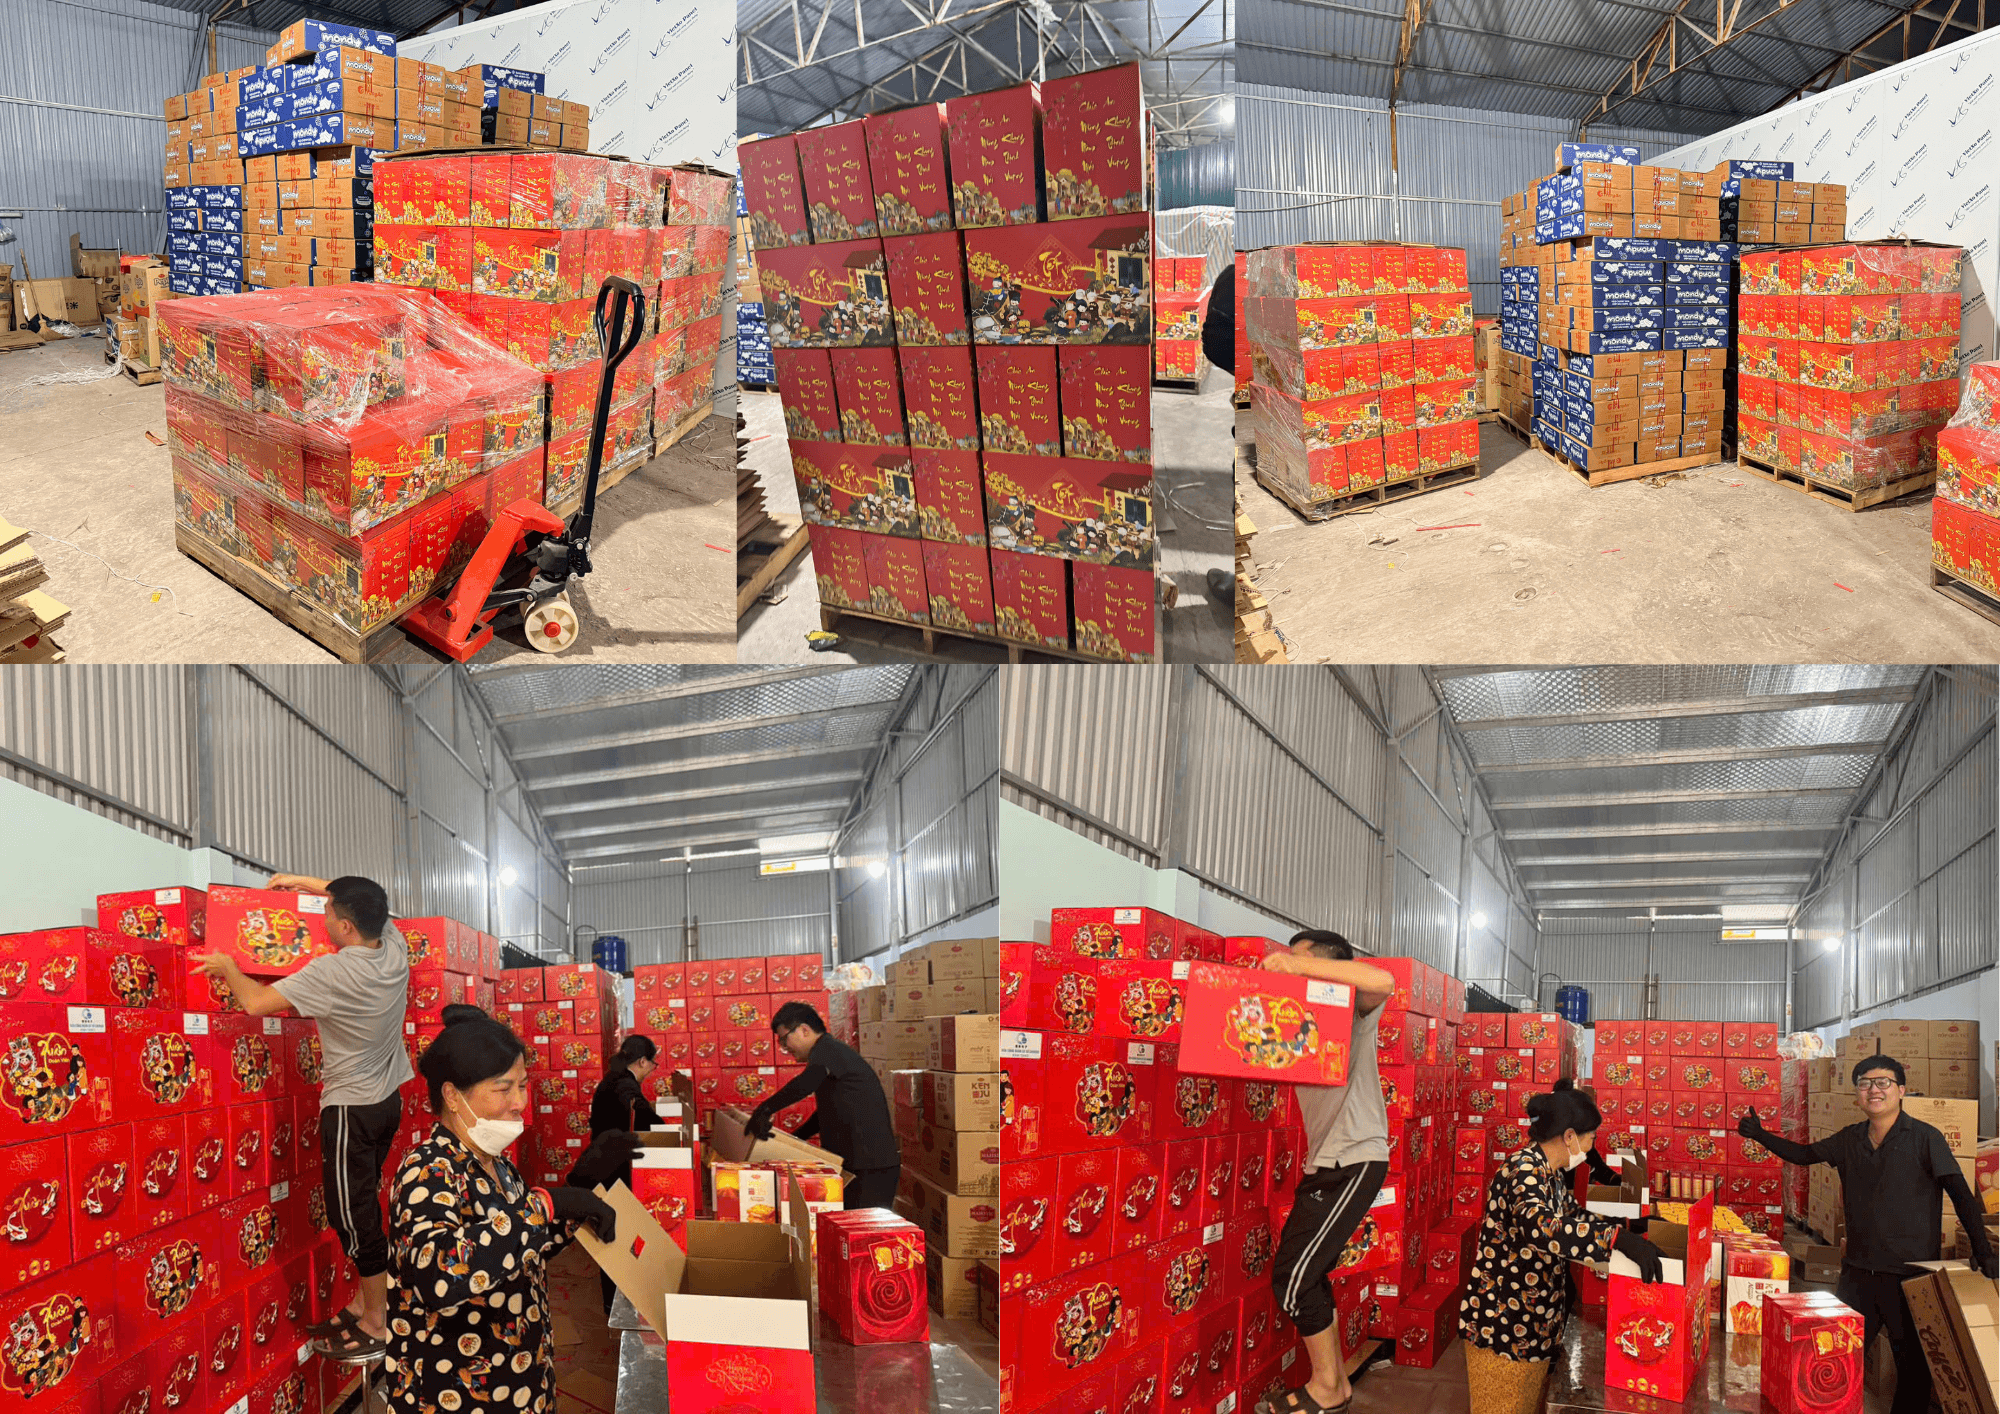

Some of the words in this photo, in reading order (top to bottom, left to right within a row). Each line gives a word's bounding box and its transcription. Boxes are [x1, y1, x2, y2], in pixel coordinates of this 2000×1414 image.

[682, 7, 698, 21] Panel
[321, 32, 363, 49] mondy
[345, 60, 374, 73] mondy
[678, 63, 693, 77] Panel
[508, 76, 535, 88] mondy
[613, 80, 627, 92] Panel
[1978, 73, 1993, 89] Panel
[445, 83, 468, 93] mondy
[293, 92, 318, 109] mondy
[674, 118, 689, 131] Panel
[292, 124, 318, 139] mondy
[348, 126, 375, 135] mondy
[402, 133, 426, 143] mondy
[1976, 129, 1991, 143] Panel
[1576, 150, 1610, 160] mondy
[1587, 172, 1612, 180] mondy
[1755, 167, 1783, 177] mondy
[1975, 184, 1989, 197] Panel
[1973, 238, 1987, 251] Panel
[1625, 245, 1656, 255] mondy
[1677, 246, 1706, 256] mondy
[1621, 268, 1652, 279] mondy
[1692, 269, 1720, 279] mondy
[1605, 290, 1637, 300] mondy
[1677, 289, 1705, 299] mondy
[1971, 291, 1985, 303] Panel
[1606, 313, 1637, 323] mondy
[1676, 311, 1705, 321] mondy
[1602, 336, 1634, 346] mondy
[1676, 333, 1704, 342] mondy
[1969, 343, 1983, 354] Panel
[1644, 358, 1666, 366] mondy
[1642, 380, 1664, 388] mondy
[1595, 386, 1619, 394] mondy
[1644, 402, 1666, 410] mondy
[1643, 424, 1665, 432] mondy
[1687, 419, 1708, 427] mondy
[1686, 441, 1706, 449] mondy
[971, 1082, 990, 1090] KEN
[979, 1090, 990, 1098] JU
[1919, 1325, 1967, 1392] Coffee
